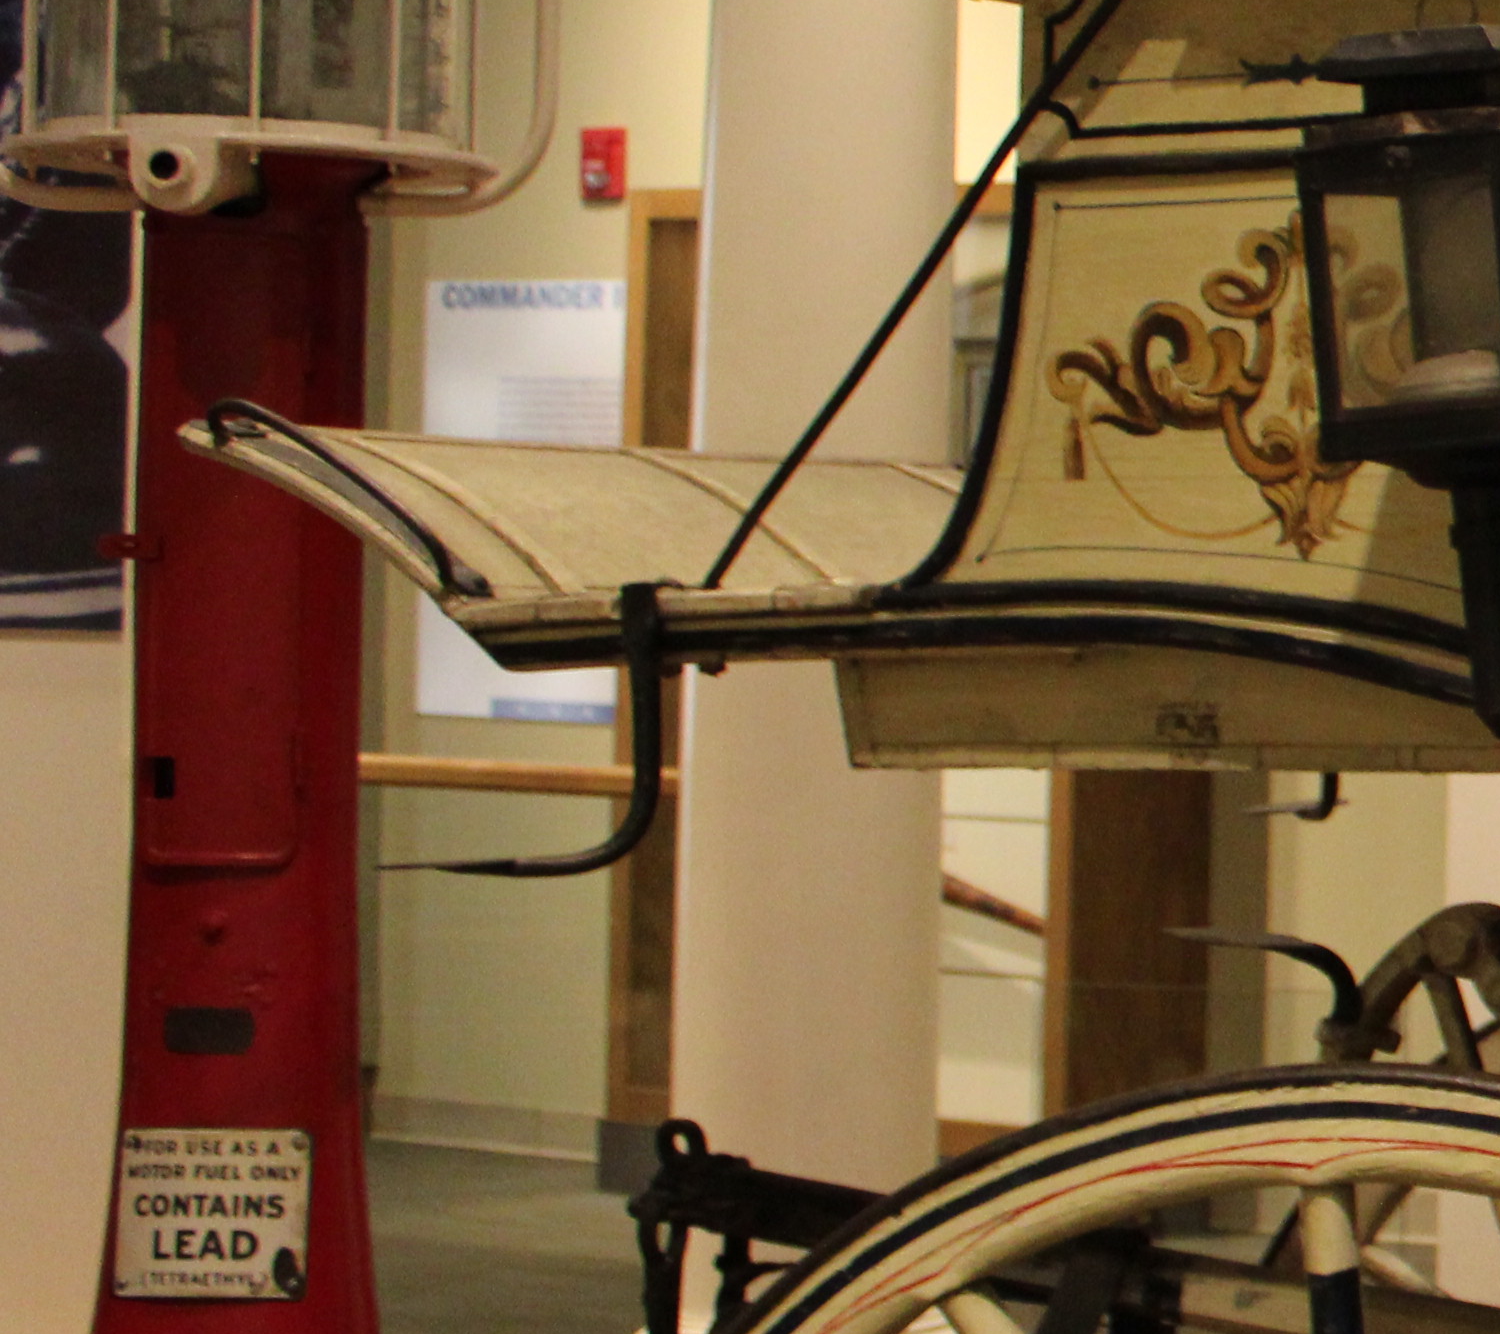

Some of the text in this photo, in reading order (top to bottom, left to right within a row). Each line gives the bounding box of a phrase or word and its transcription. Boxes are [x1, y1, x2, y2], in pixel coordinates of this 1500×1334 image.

[442, 283, 603, 309] COMMANDER
[186, 1140, 222, 1155] USE
[232, 1141, 257, 1155] AS
[267, 1140, 281, 1155] A
[128, 1165, 300, 1181] MOTOR FUEL ONLY
[134, 1193, 286, 1219] CONTAINS
[153, 1229, 260, 1260] LEAD
